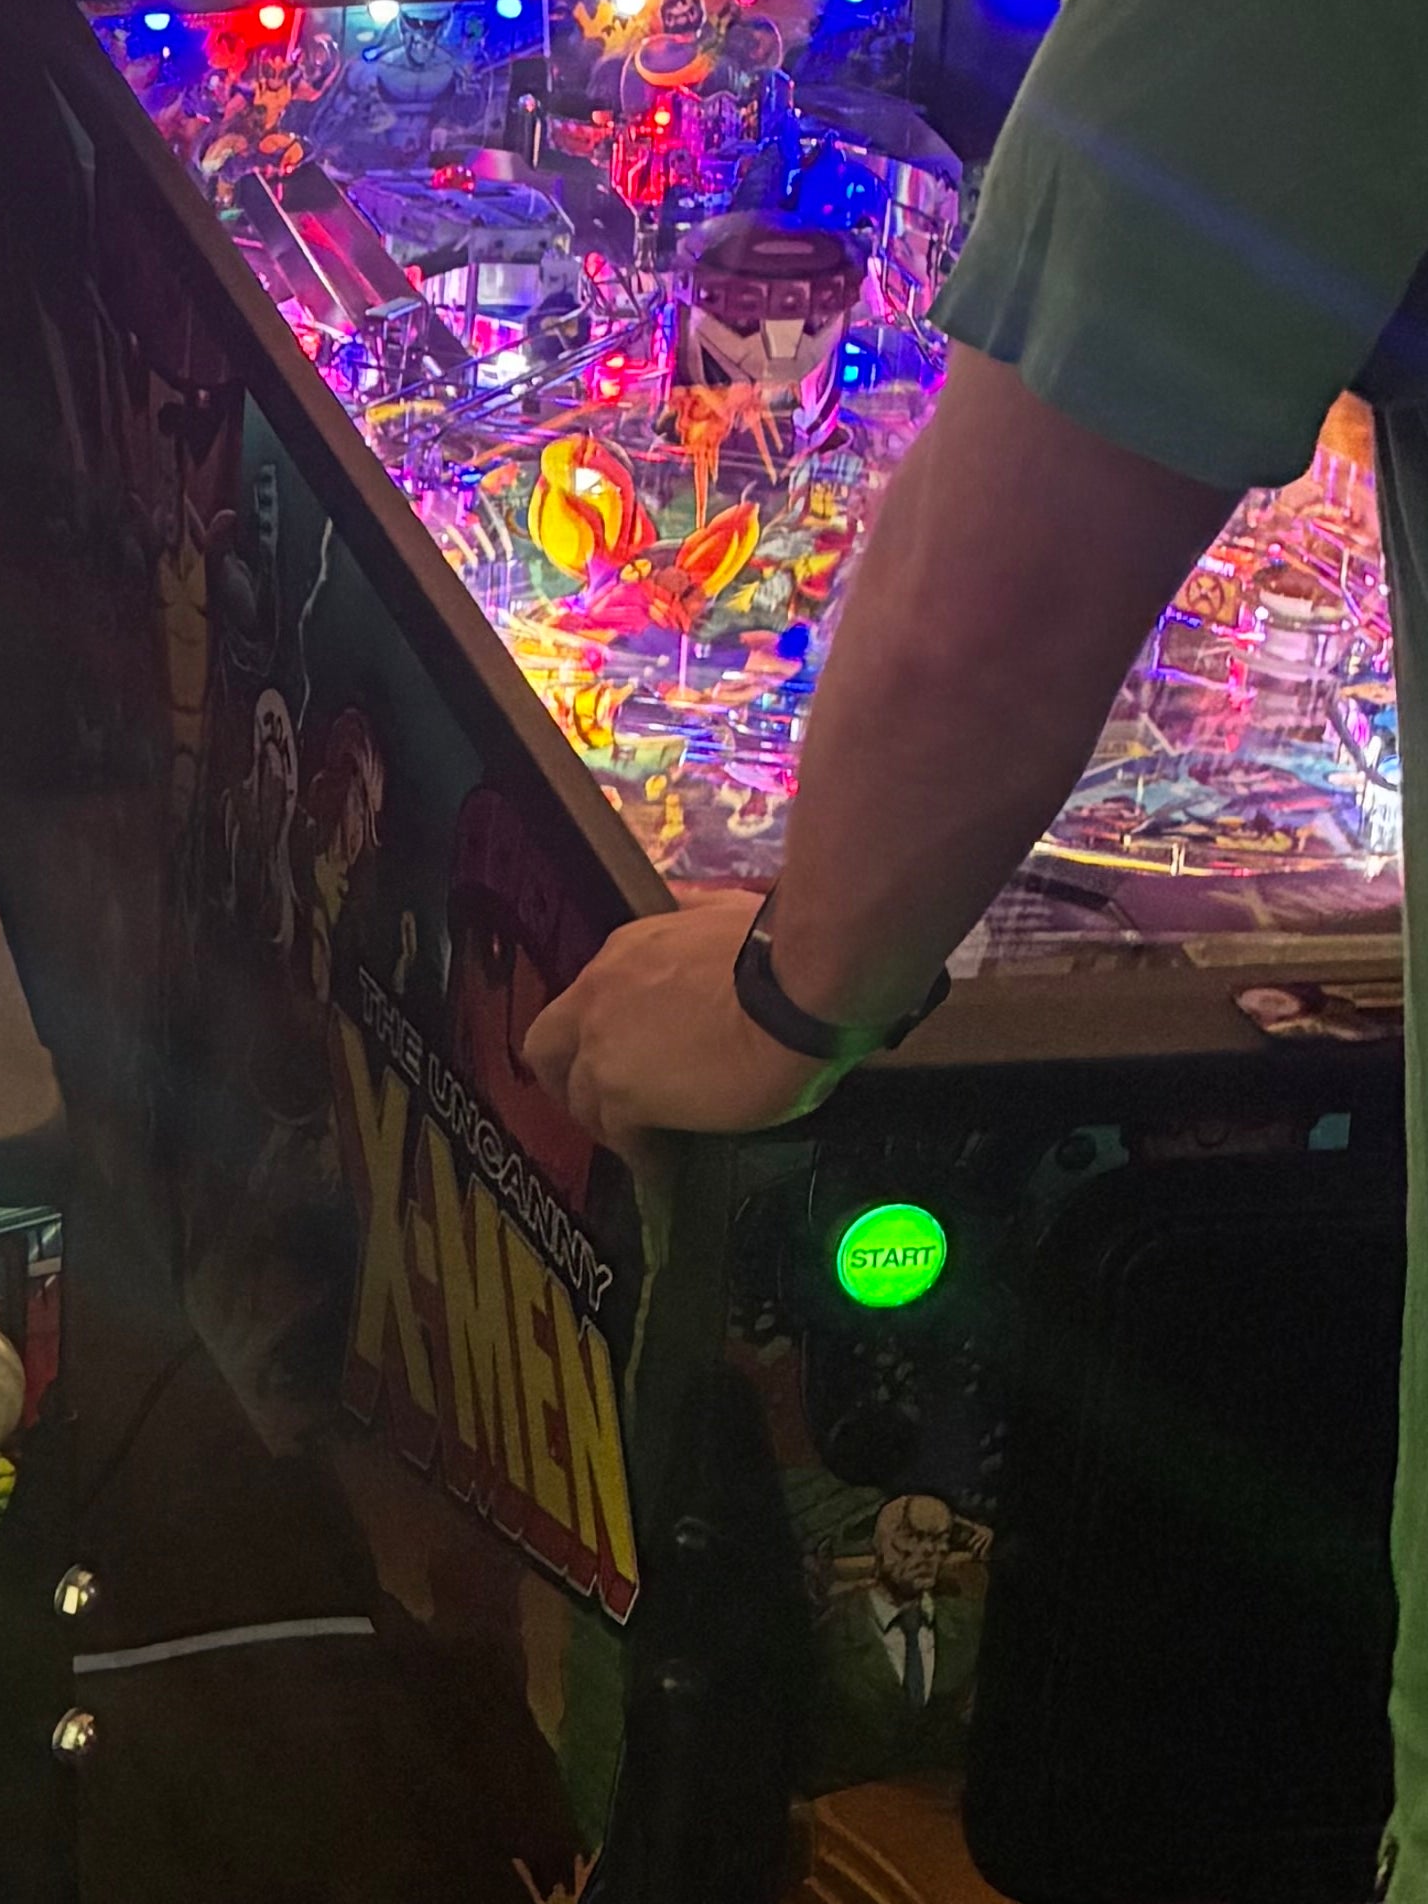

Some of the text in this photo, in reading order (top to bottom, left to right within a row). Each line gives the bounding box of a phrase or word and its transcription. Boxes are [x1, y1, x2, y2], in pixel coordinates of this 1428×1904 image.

[358, 964, 615, 1312] THE UNCANNY
[850, 1245, 937, 1269] START
[330, 1002, 641, 1627] X-MEN
